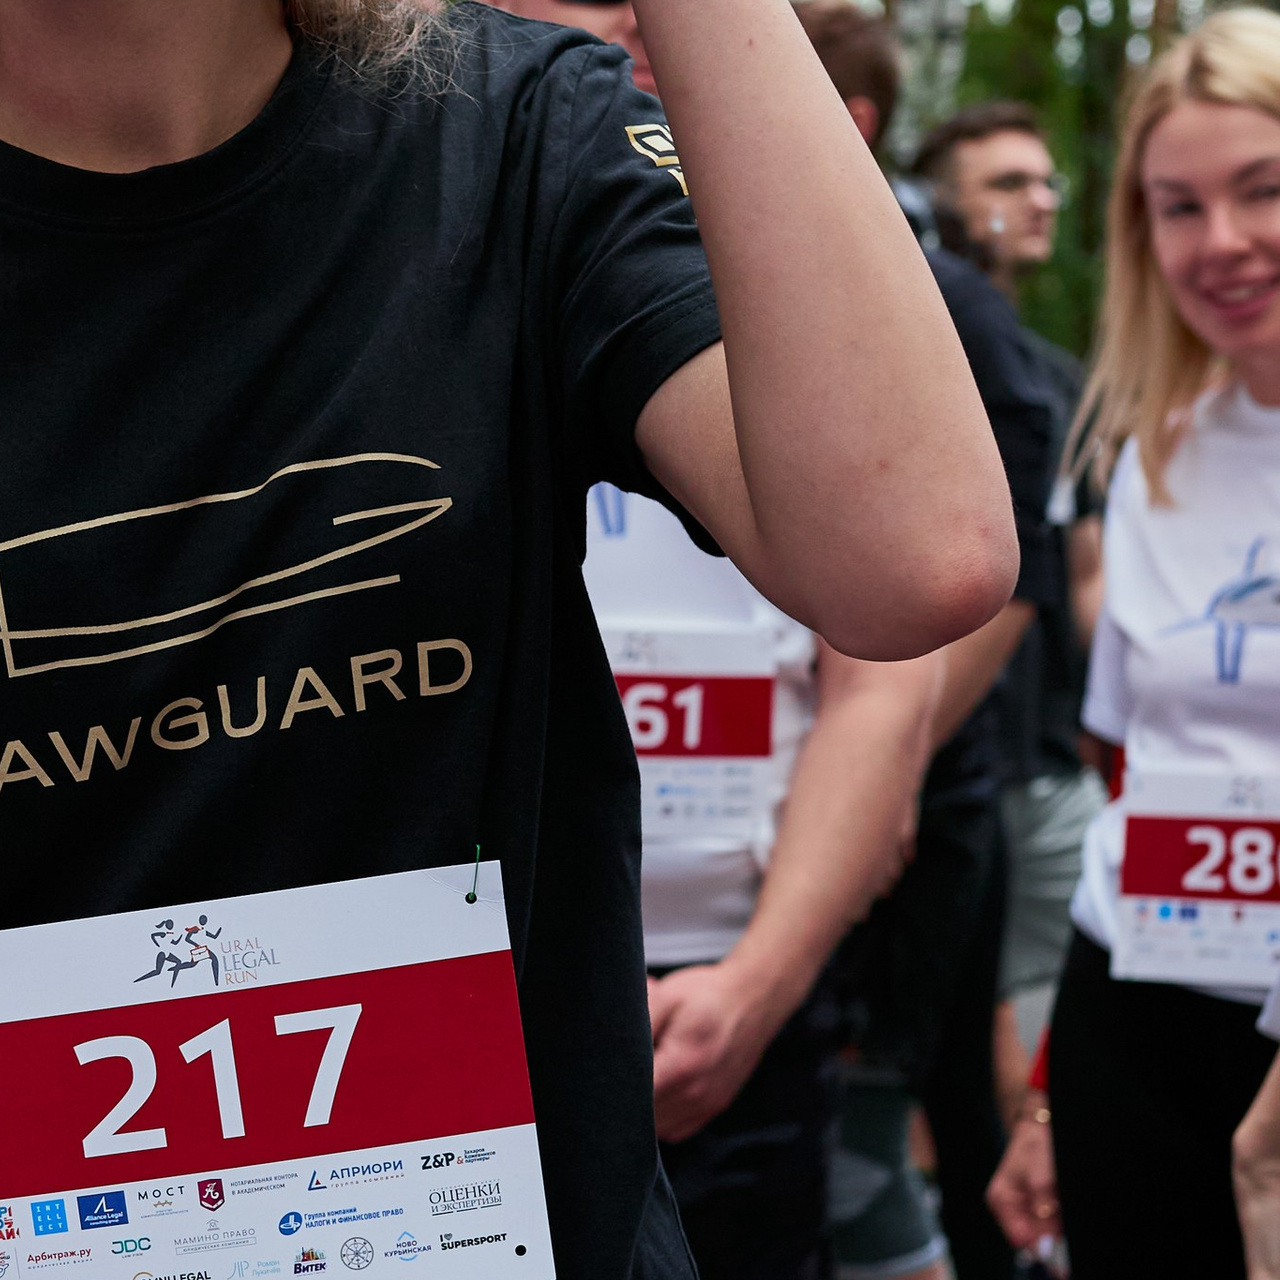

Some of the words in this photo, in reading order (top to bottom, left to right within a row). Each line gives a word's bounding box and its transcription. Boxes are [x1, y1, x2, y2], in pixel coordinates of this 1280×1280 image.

[1182, 825, 1280, 893] 28
[220, 937, 262, 953] URAL
[222, 948, 281, 972] LEGAL
[225, 970, 258, 985] RUN
[72, 1002, 363, 1159] 217
[421, 1152, 455, 1170] Z&P
[330, 1160, 404, 1180] АПРИОРИ
[230, 1176, 273, 1187] НОТАРИАЛЬНАЯ
[274, 1173, 298, 1181] КОНТОРА
[237, 1183, 285, 1195] АКАДЕМИЧЕСКОМ
[429, 1182, 500, 1204] ОЦЕНКИ
[431, 1205, 439, 1213] И
[441, 1196, 502, 1211] ЭКСПЕРТИЗЫ
[85, 1214, 107, 1222] Alliance
[108, 1212, 123, 1220] Legal
[304, 1212, 326, 1220] Группа
[327, 1207, 357, 1217] компаний
[305, 1219, 331, 1228] НАЛОГИ
[338, 1213, 380, 1224] ФИНАНСОВОЕ
[382, 1208, 404, 1217] ПРАВО
[174, 1233, 219, 1246] МАМИНО
[223, 1228, 256, 1240] ПРАВО
[396, 1240, 417, 1248] НОВО
[441, 1233, 507, 1251] SUPERSPORT
[111, 1237, 151, 1255] JDC
[384, 1245, 432, 1257] КУРЬИНСКАЯ
[27, 1248, 91, 1264] Арбитраж.ру
[257, 1260, 280, 1268] Роман
